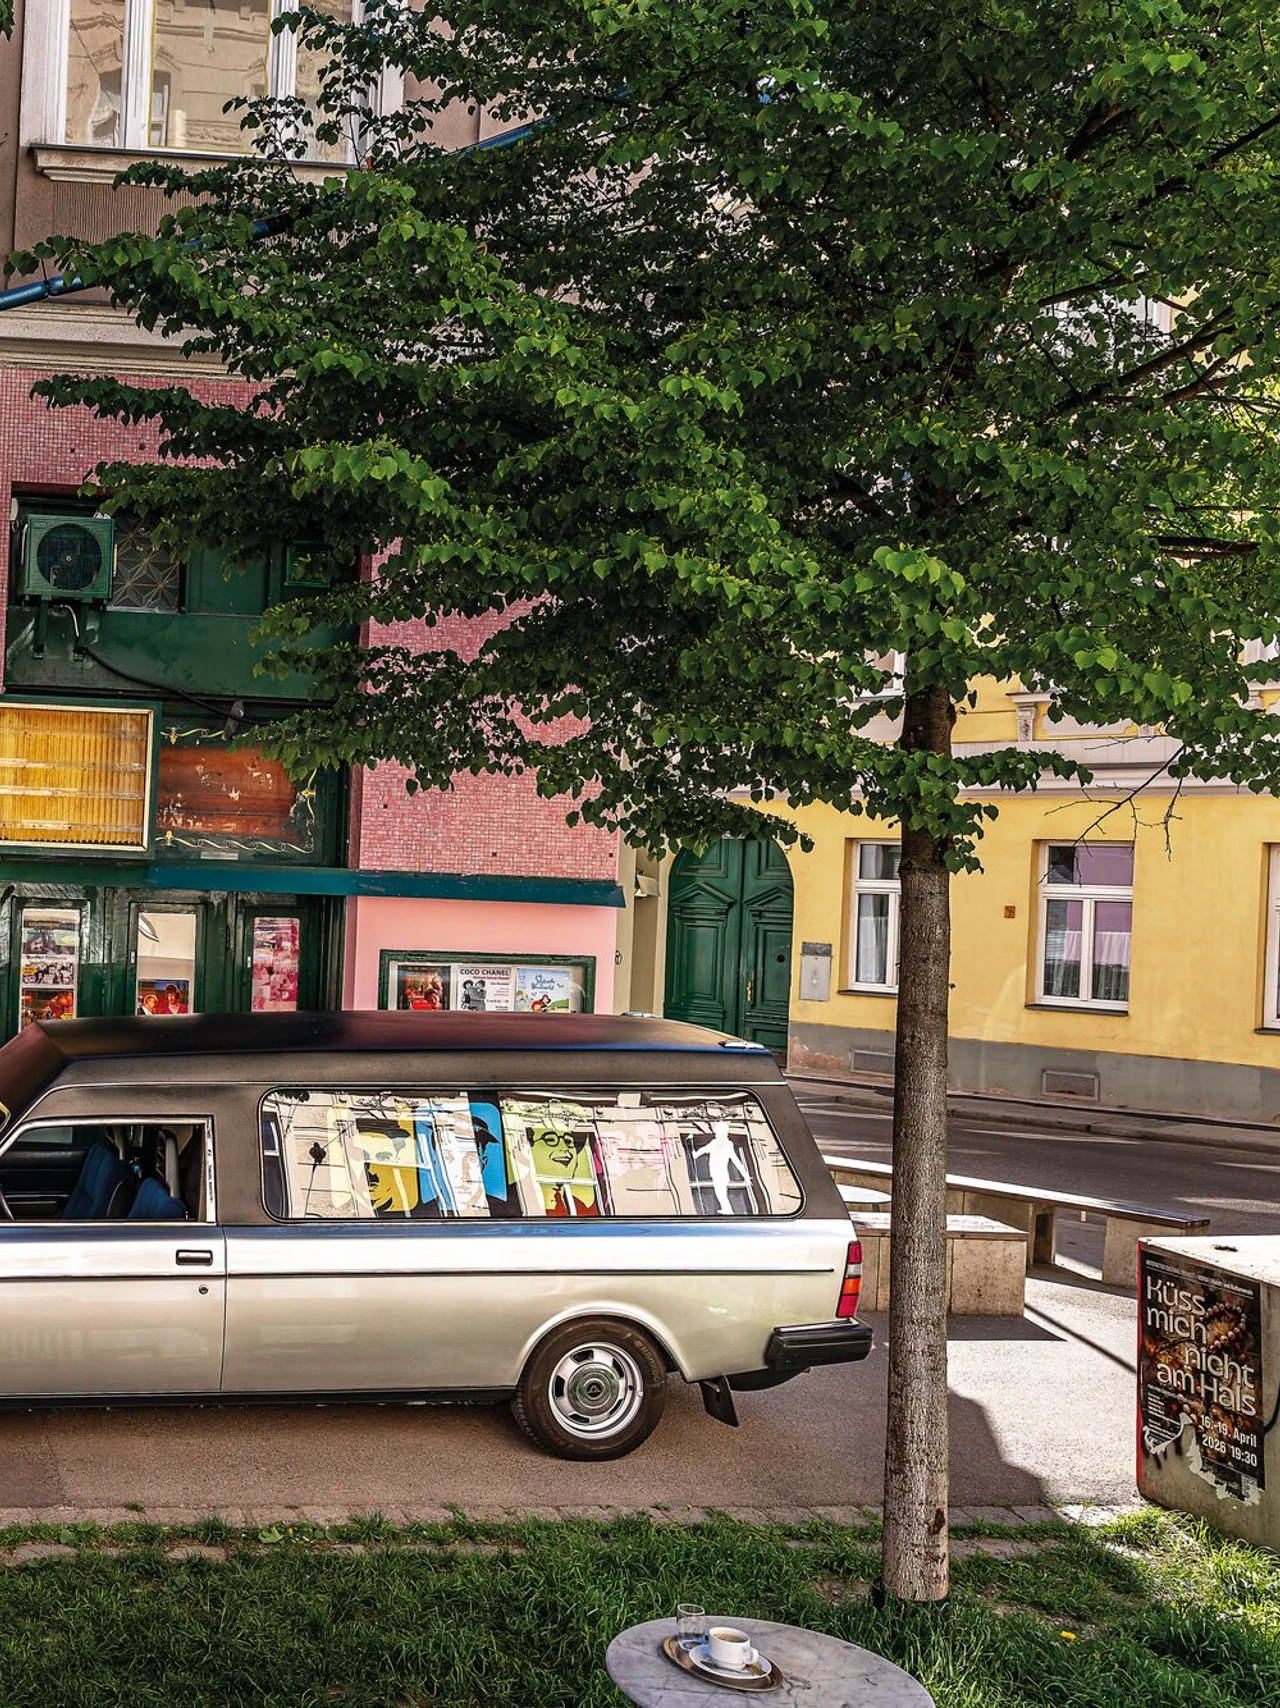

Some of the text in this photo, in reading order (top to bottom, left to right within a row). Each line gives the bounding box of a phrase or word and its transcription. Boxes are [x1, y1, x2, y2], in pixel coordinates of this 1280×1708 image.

[1146, 1275, 1206, 1316] Küss
[1146, 1305, 1207, 1343] mich
[1185, 1346, 1255, 1389] nicht
[1157, 1363, 1195, 1394] am
[1200, 1373, 1257, 1417] Hals
[1201, 1415, 1231, 1438] 16.-19.
[1233, 1427, 1257, 1447] April
[1202, 1434, 1258, 1467] 2026 19:30
